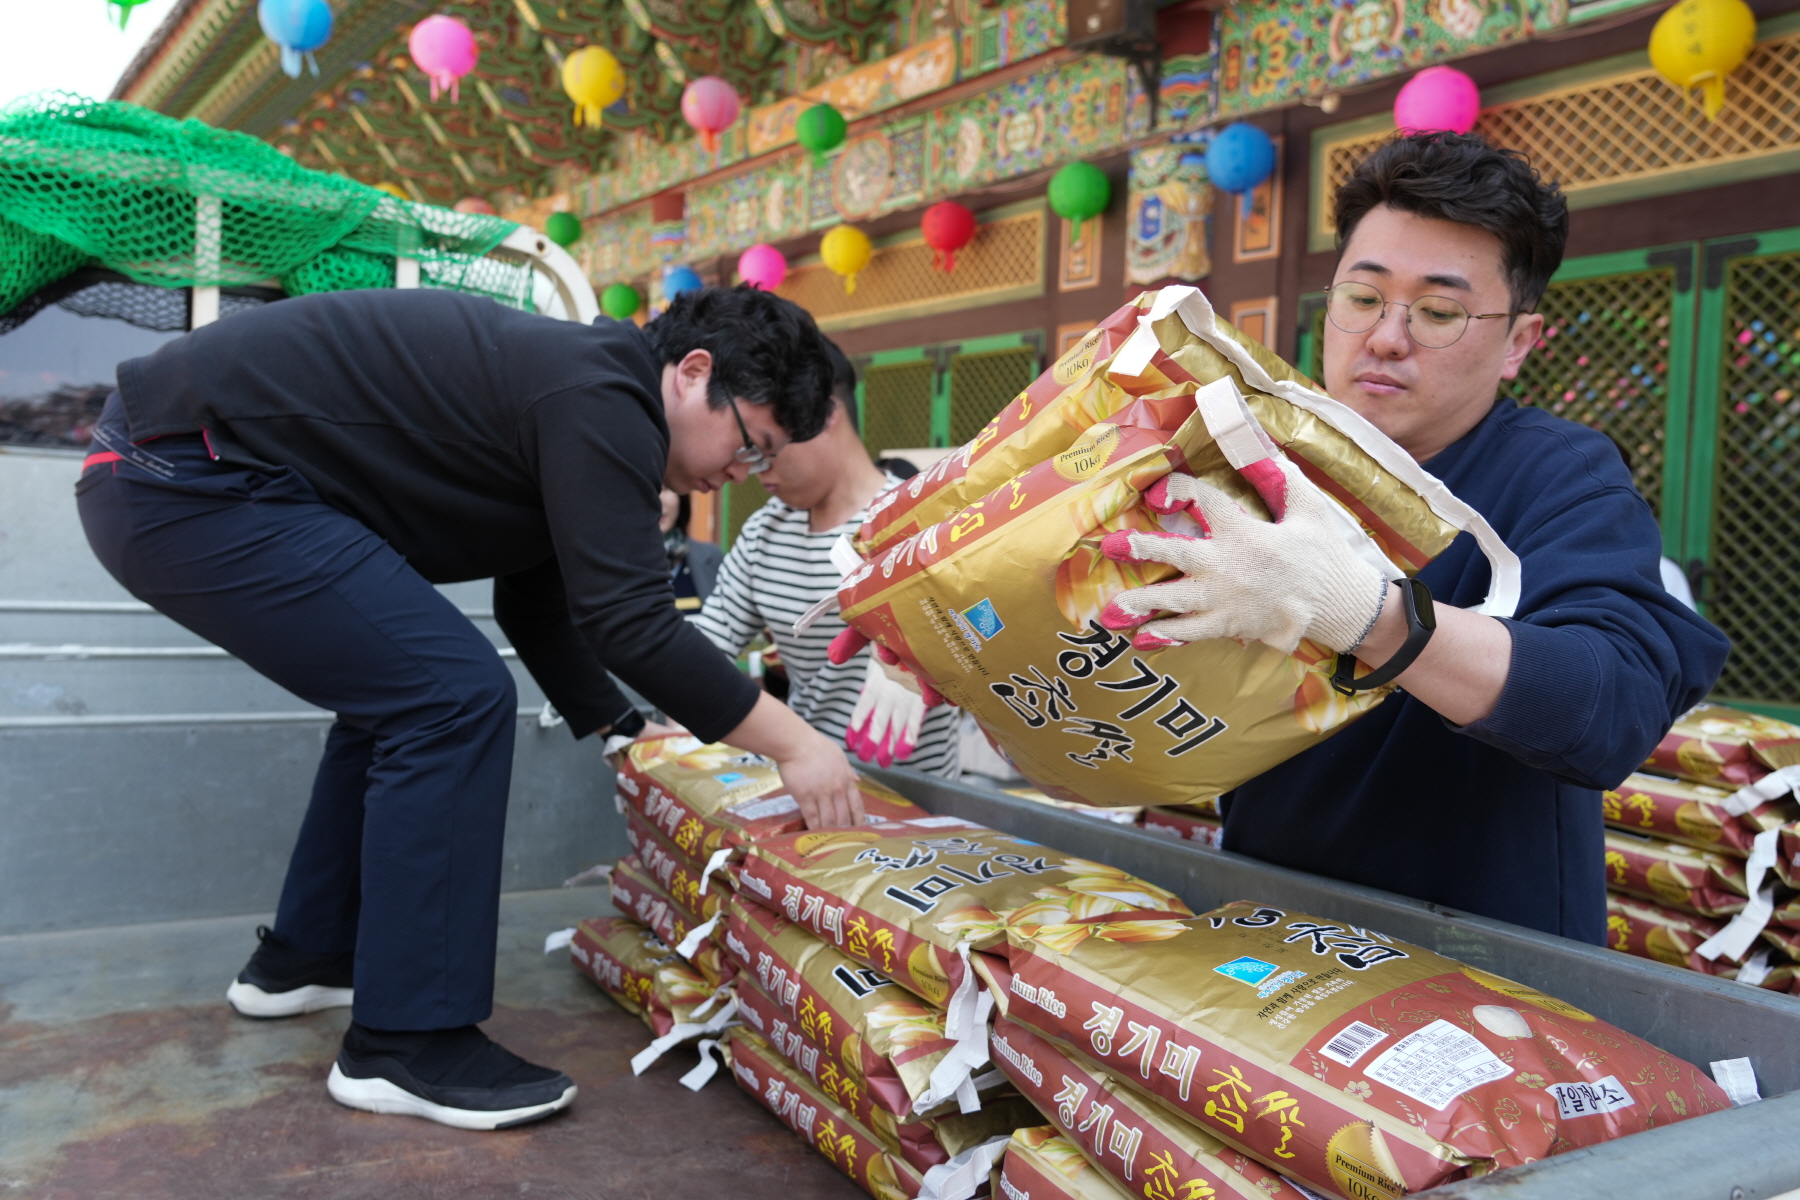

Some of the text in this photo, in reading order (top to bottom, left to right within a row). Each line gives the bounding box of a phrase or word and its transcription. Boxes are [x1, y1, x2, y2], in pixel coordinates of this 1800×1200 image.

[1059, 337, 1099, 370] Premium Rice
[1066, 358, 1089, 378] 10kg
[1060, 432, 1110, 462] Premium Rice
[1074, 454, 1101, 474] 10kg
[1056, 618, 1229, 758] 경기미
[884, 853, 1063, 914] 경기미
[781, 883, 845, 945] 경기미
[757, 951, 801, 1021] 경기미
[1037, 986, 1066, 1018] Rice
[1291, 977, 1318, 994] 사랑으로
[770, 1018, 819, 1086] 경기미
[1020, 1048, 1042, 1087] Rice
[1083, 1000, 1201, 1101] 경기미
[765, 1077, 817, 1144] 경기미
[1053, 1075, 1143, 1181] 경기미
[1335, 1154, 1397, 1194] Premium Rice
